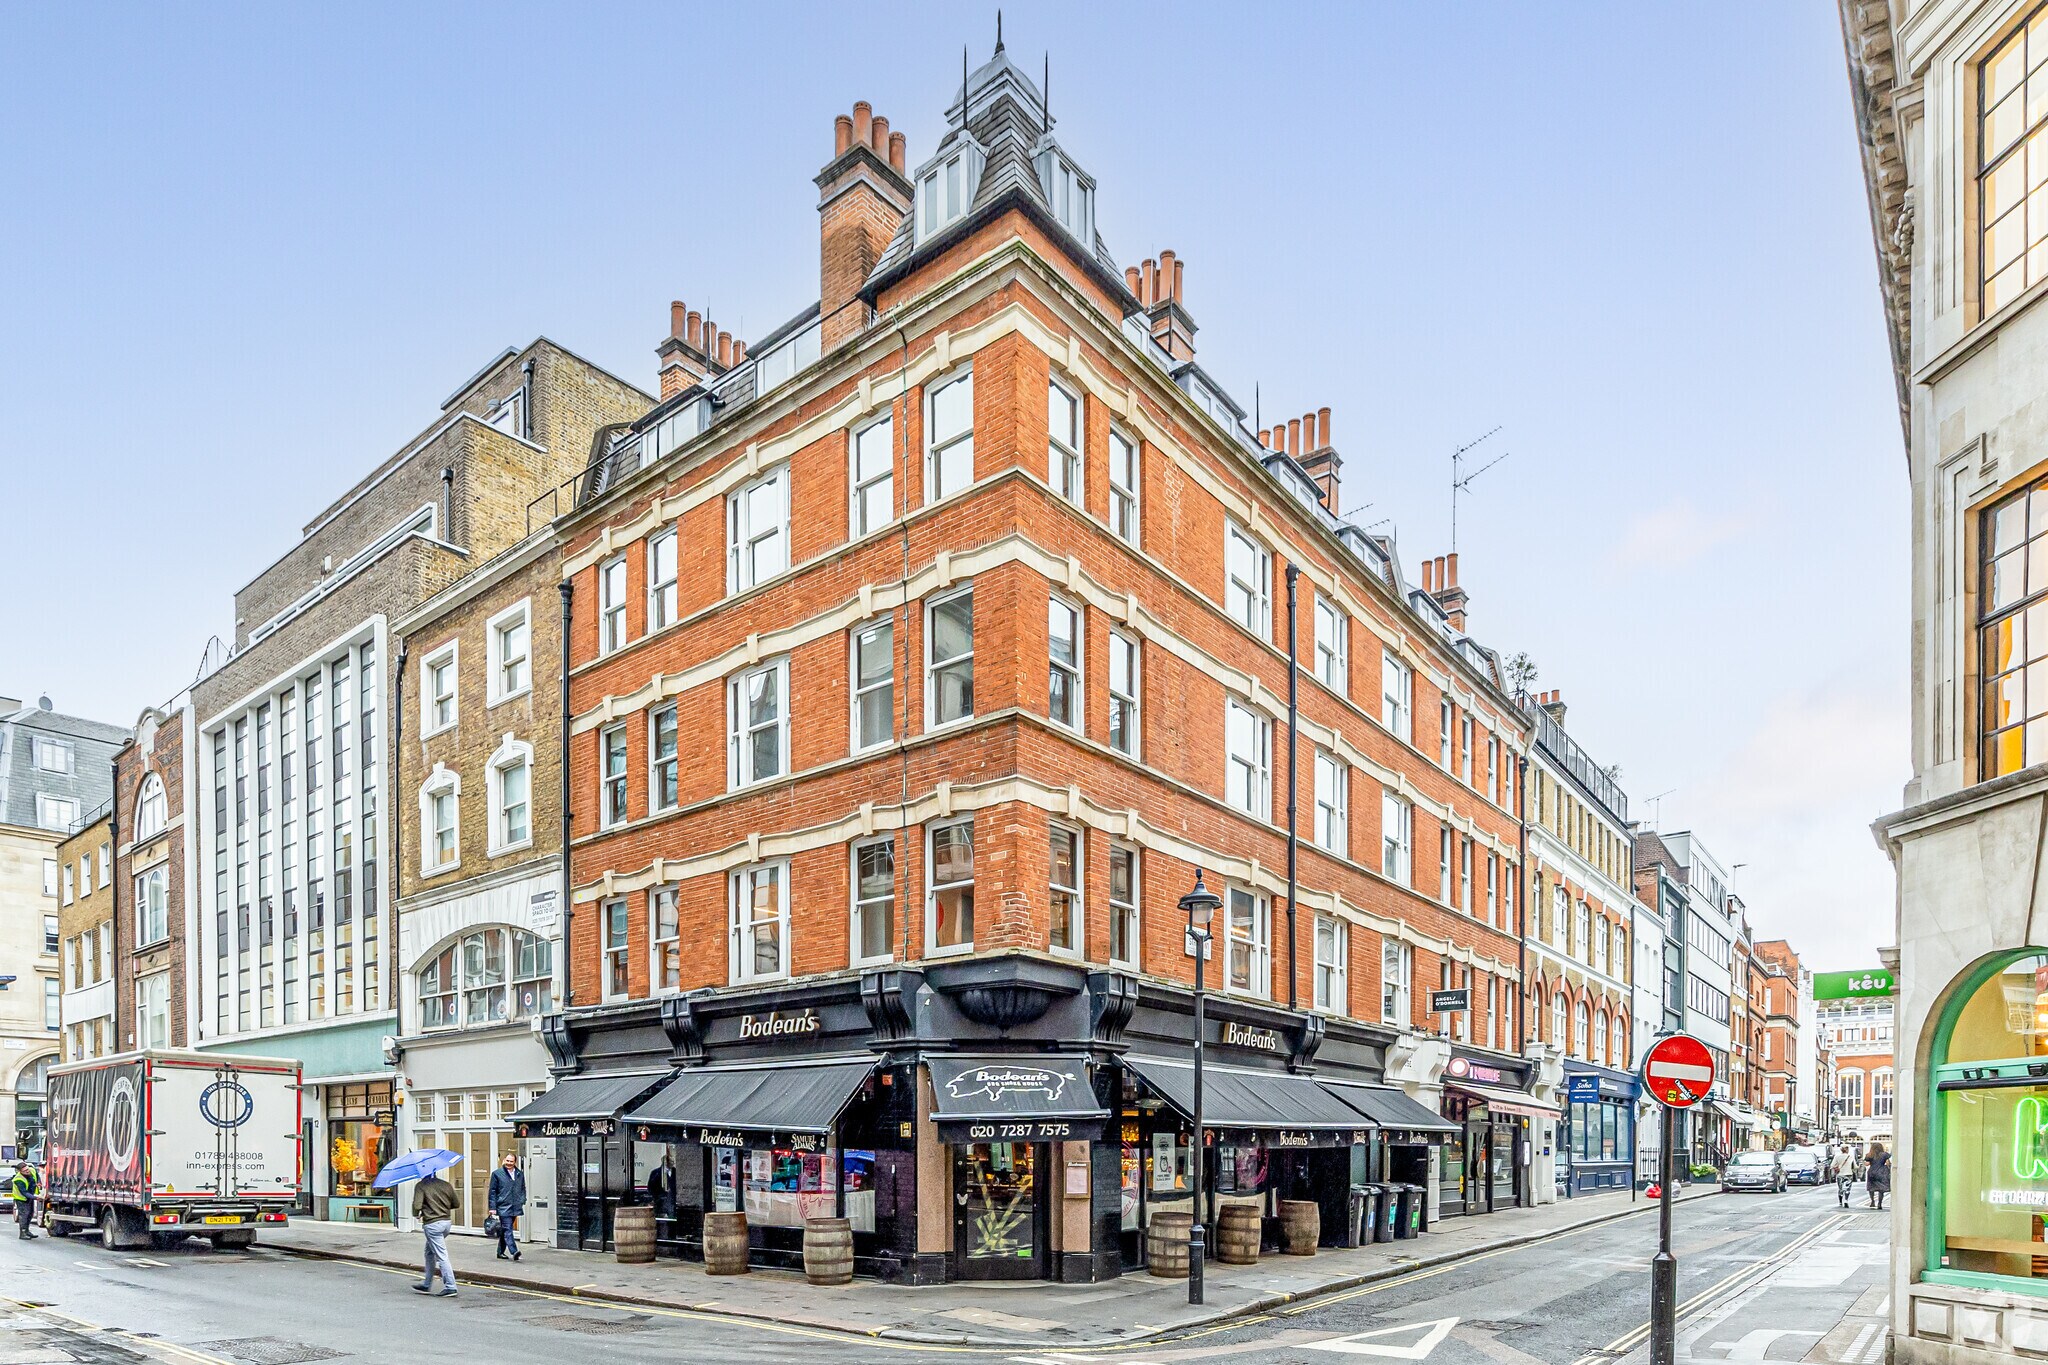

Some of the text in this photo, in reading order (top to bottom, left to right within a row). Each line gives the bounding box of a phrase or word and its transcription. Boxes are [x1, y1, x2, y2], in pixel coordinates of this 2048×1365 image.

[1848, 974, 1886, 991] kêu
[739, 1008, 815, 1038] Bodean's
[1228, 1022, 1276, 1050] Bodean's
[976, 1070, 1050, 1082] Bodean's
[545, 1121, 579, 1135] Bodean's
[970, 1123, 1070, 1138] 020 7287 7575
[700, 1128, 744, 1147] Bodean's
[791, 1133, 816, 1144] SAMUEL
[792, 1141, 815, 1152] ADAMS
[195, 1152, 225, 1160] 01789
[186, 1161, 265, 1171] inn-express.com
